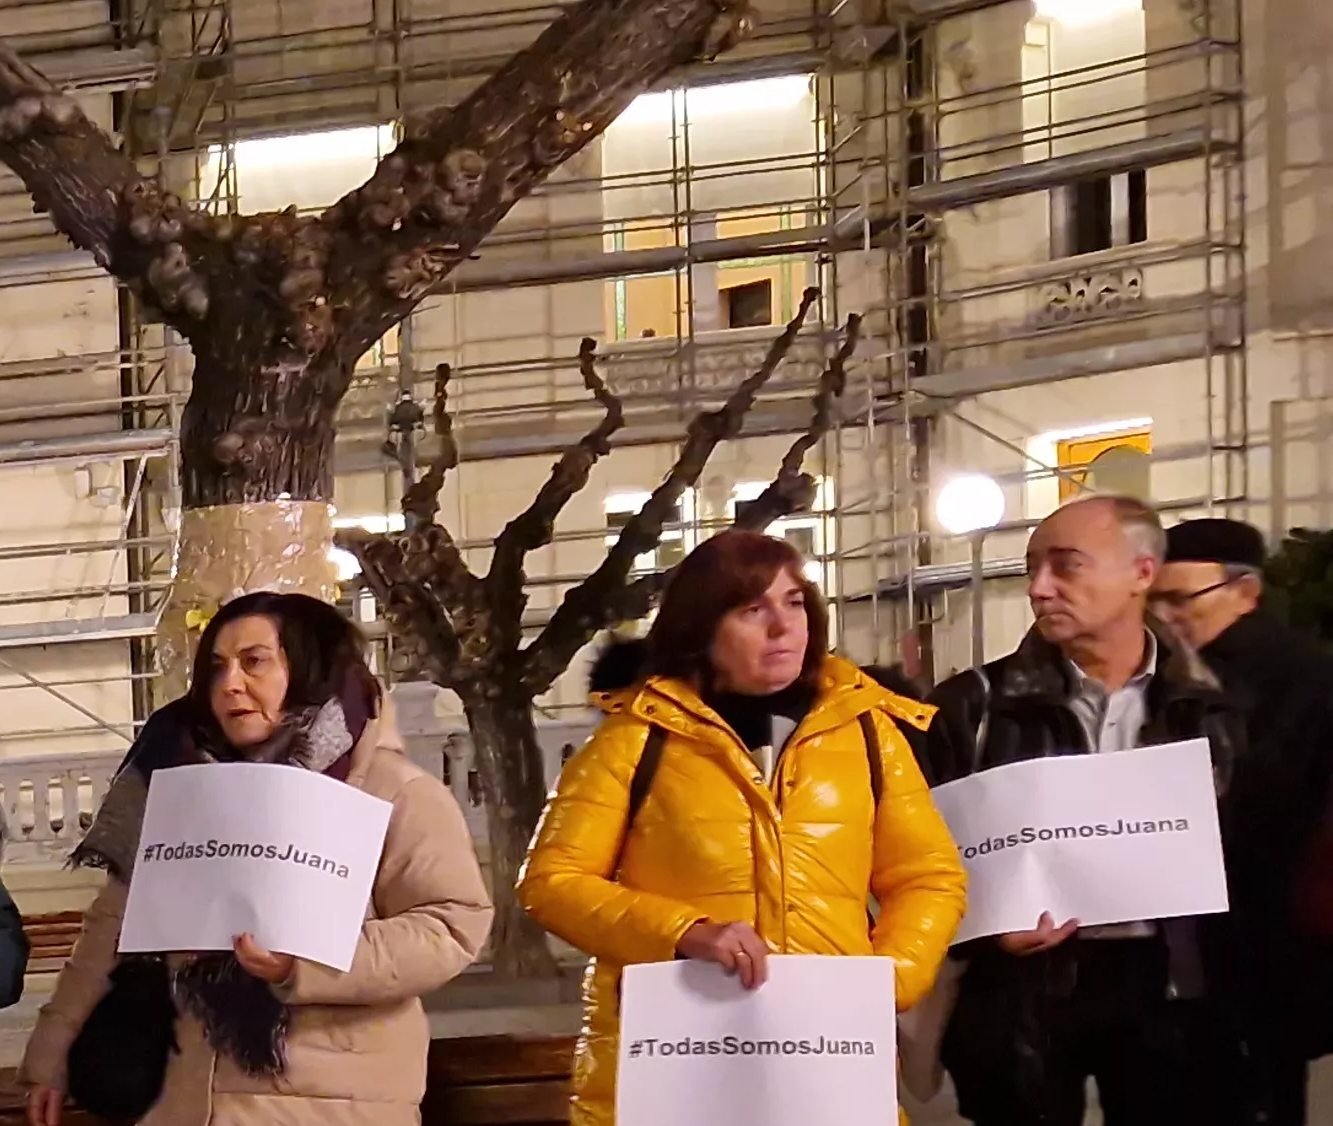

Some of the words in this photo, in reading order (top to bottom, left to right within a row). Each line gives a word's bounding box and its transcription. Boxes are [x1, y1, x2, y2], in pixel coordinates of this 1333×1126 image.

[957, 818, 1190, 860] odasSomosJuana
[144, 840, 350, 879] #TodasSomosJuana
[629, 1035, 875, 1058] #TodasSomosJuana
